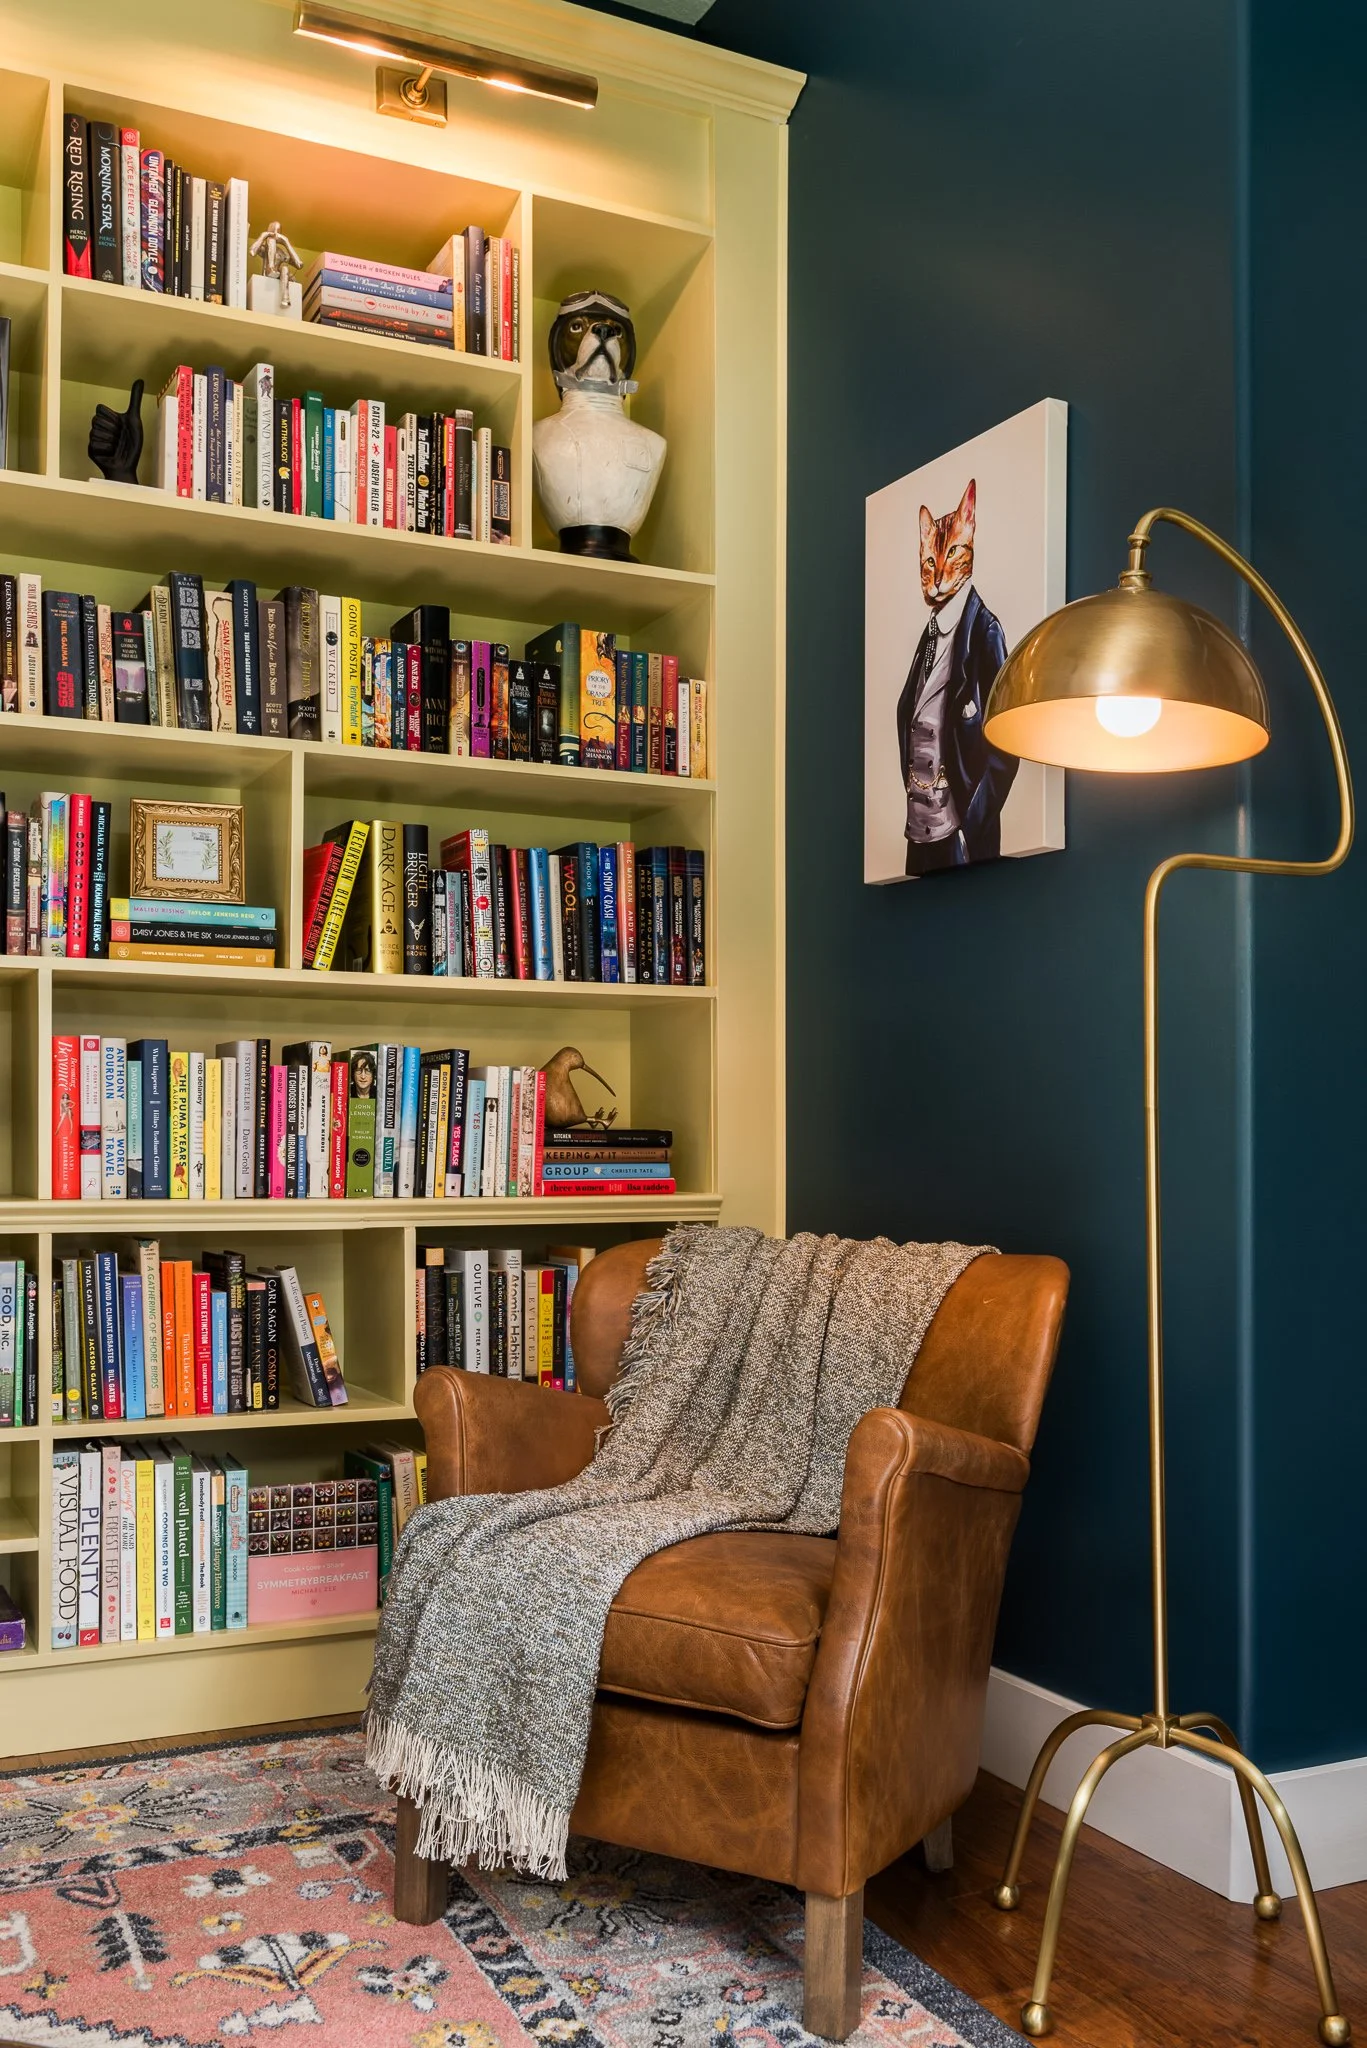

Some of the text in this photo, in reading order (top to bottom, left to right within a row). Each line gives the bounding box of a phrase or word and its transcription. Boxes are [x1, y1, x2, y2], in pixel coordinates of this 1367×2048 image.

[66, 136, 84, 220] RED RISING
[98, 146, 113, 234] MORNING STAR
[148, 156, 159, 264] UNTAMED GLENNON DOYLE
[371, 406, 380, 512] CATCH-22 JOSEPH HELLER
[418, 428, 429, 528] The Godfather Mario Puzo
[268, 608, 276, 622] RED
[88, 644, 96, 676] GAIMAN
[222, 620, 232, 706] SATAN JEREMY LEVEN
[348, 604, 359, 728] GOING POSTAL Terry Pratchett
[88, 679, 97, 718] STARDUST
[97, 815, 106, 846] MICHAEL
[378, 827, 396, 913] DARK AGE
[404, 852, 418, 908] BRINGER
[418, 852, 428, 892] LIGHT
[564, 864, 576, 915] WOOL
[93, 884, 103, 942] RICHARD PAUL EVANS
[318, 829, 366, 958] RECURSION BLAKE CROUCH
[604, 871, 614, 918] SNOW CRASH
[132, 928, 153, 936] DAISY
[154, 929, 179, 938] JONES
[180, 930, 186, 938] &
[201, 932, 212, 940] SIX
[56, 1040, 72, 1091] Beyoncé
[106, 1047, 114, 1099] BOURDAIN
[150, 1065, 159, 1094] Happened
[261, 1078, 266, 1088] OF
[152, 1110, 160, 1129] Hillary
[288, 1110, 296, 1122] YOU
[455, 1076, 464, 1118] POEHLER
[106, 1138, 114, 1178] TRAVEL
[242, 1129, 250, 1175] Dave Grohl
[288, 1134, 296, 1180] MIRANDA JULY
[452, 1141, 460, 1166] PLEASE
[545, 1167, 589, 1176] GROUP
[546, 1152, 616, 1160] KEEPING AT IT
[105, 1272, 111, 1281] TO
[474, 1264, 482, 1308] OUTLIVE
[1, 1287, 12, 1350] FOOD, INC.
[150, 1323, 156, 1334] OF
[268, 1280, 276, 1390] CARL SAGAN COSMOS
[510, 1274, 520, 1368] Atomic Habits
[183, 1333, 191, 1356] Think
[176, 1492, 190, 1558] well plated
[382, 1488, 390, 1532] VEGETARIAN
[59, 1474, 78, 1620] VISUAL FOOD
[81, 1507, 100, 1598] PLENTY
[105, 1516, 118, 1590] FOREST FEAST
[256, 1571, 370, 1590] SYMMETRYBREAKFAST
